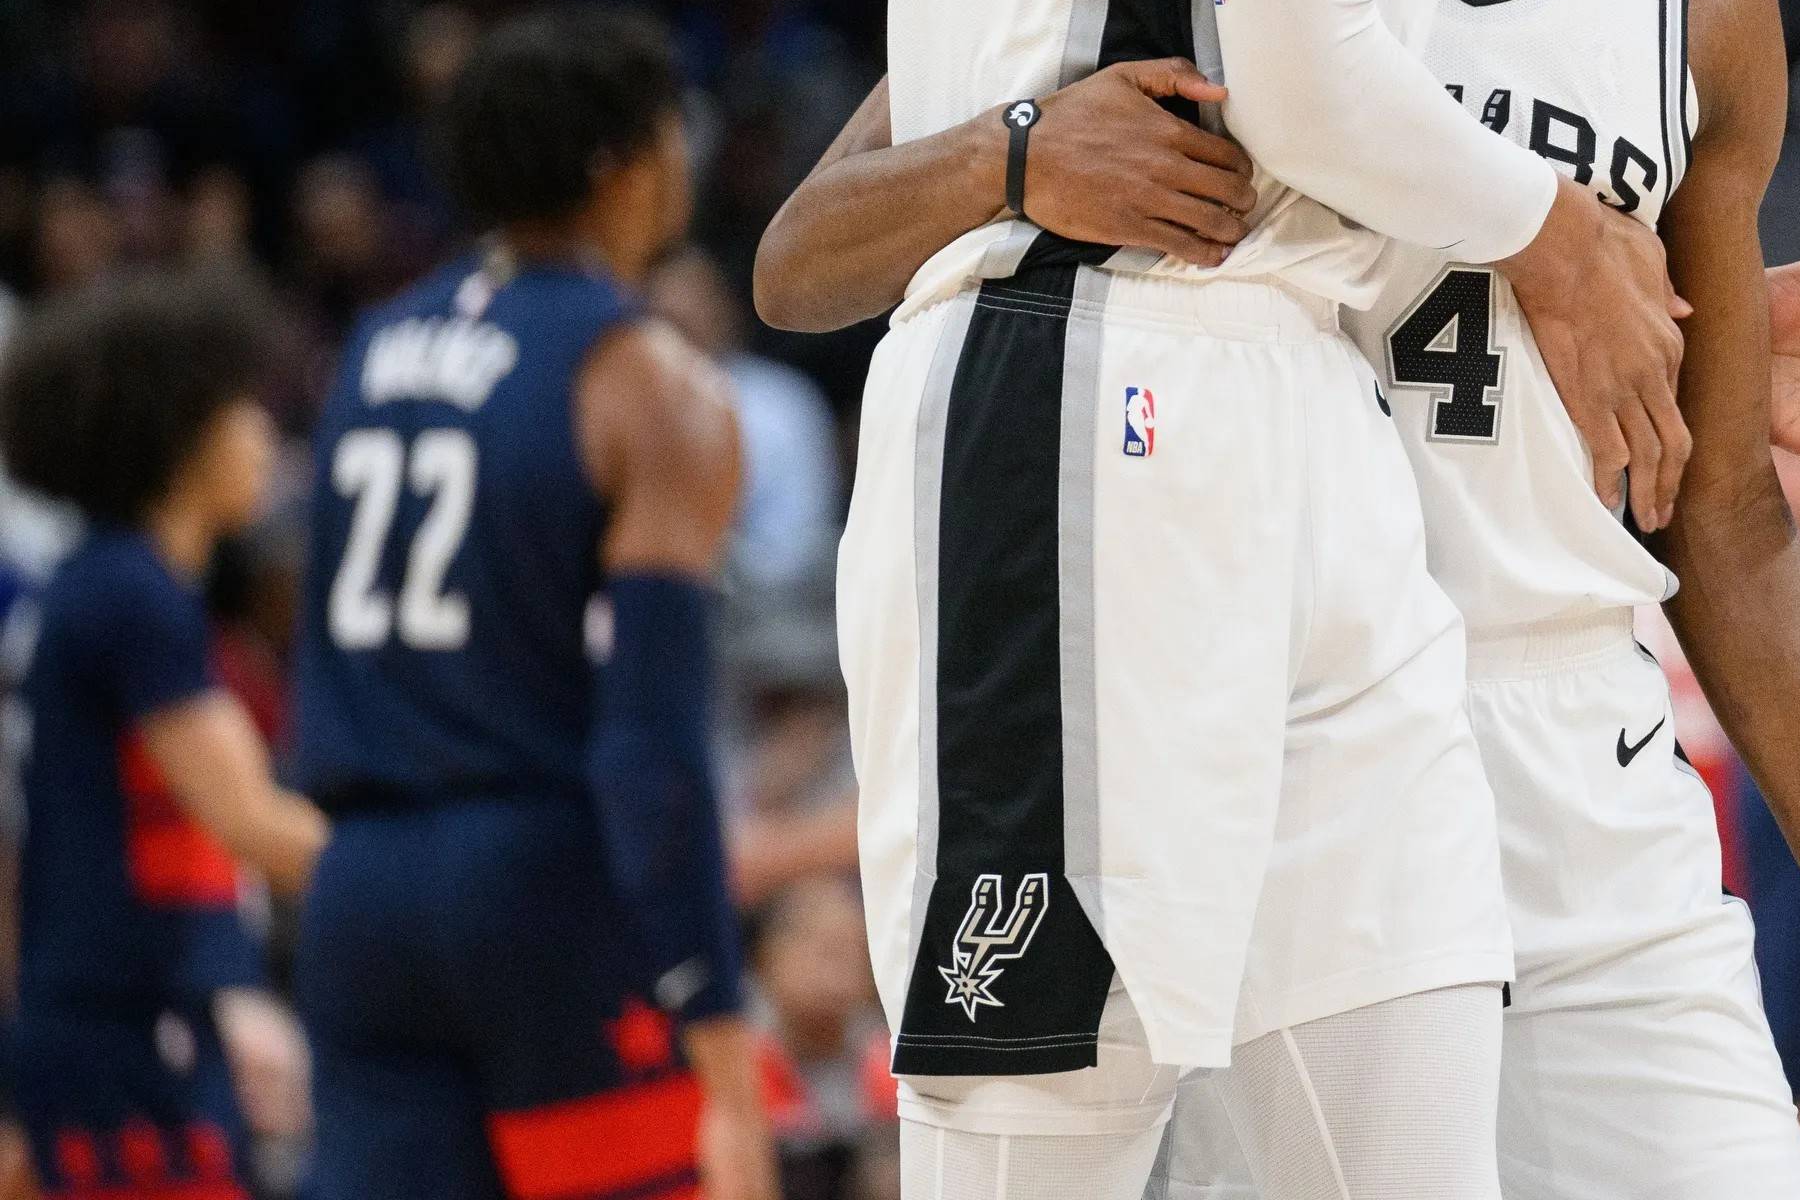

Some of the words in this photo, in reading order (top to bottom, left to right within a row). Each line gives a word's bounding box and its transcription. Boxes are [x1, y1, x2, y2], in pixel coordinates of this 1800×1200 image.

[1383, 261, 1508, 446] 4
[327, 426, 481, 651] 22
[1126, 440, 1144, 454] NBA
